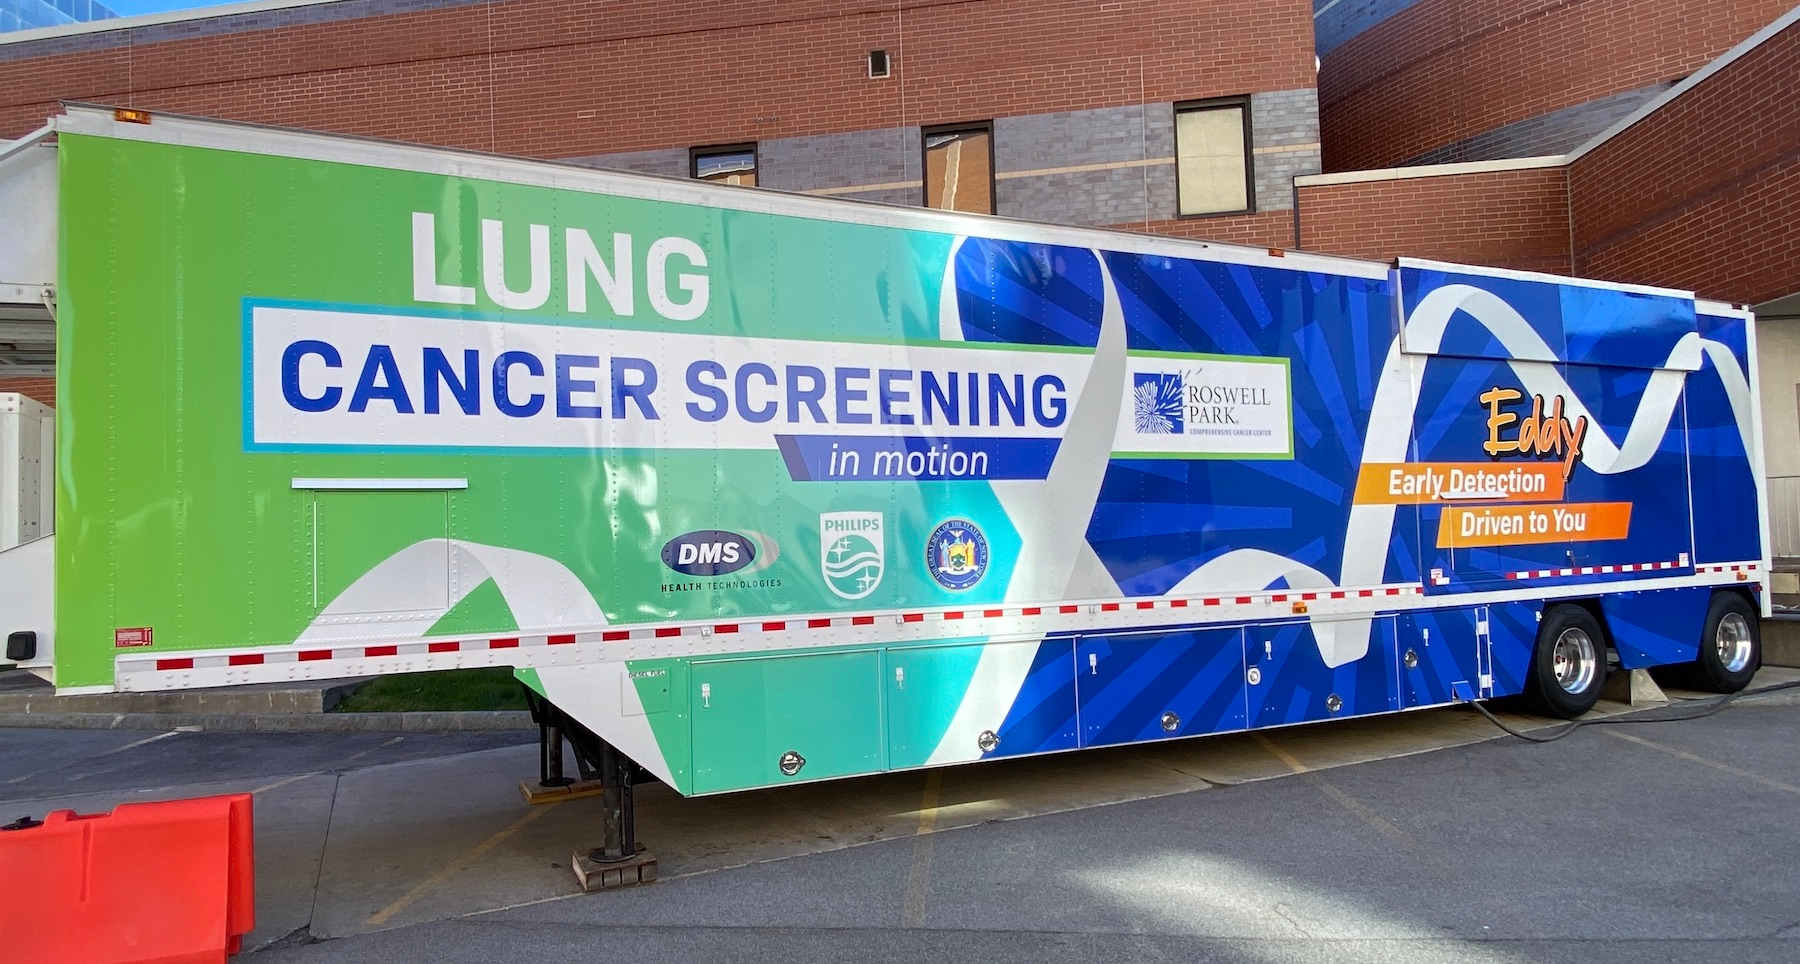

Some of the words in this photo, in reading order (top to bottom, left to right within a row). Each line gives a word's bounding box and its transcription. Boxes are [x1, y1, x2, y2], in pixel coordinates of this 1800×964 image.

[412, 212, 710, 321] LUNG
[281, 340, 661, 420] CANCER
[685, 360, 1067, 428] SCREENING
[1189, 386, 1271, 405] ROSWELL
[1190, 428, 1232, 436] COMPREHENSIVE
[1480, 387, 1586, 480] Eddy
[829, 443, 859, 476] in
[872, 444, 988, 477] motion
[1388, 467, 1444, 500] Early
[1450, 468, 1545, 494] Detection
[824, 518, 880, 532] PHILIPS
[1461, 510, 1523, 537] Driven
[1529, 512, 1548, 533] to
[1552, 509, 1586, 532] You
[677, 542, 740, 566] DMS
[661, 583, 702, 593] HEALTH
[707, 579, 782, 591] TECHNOLOGIES
